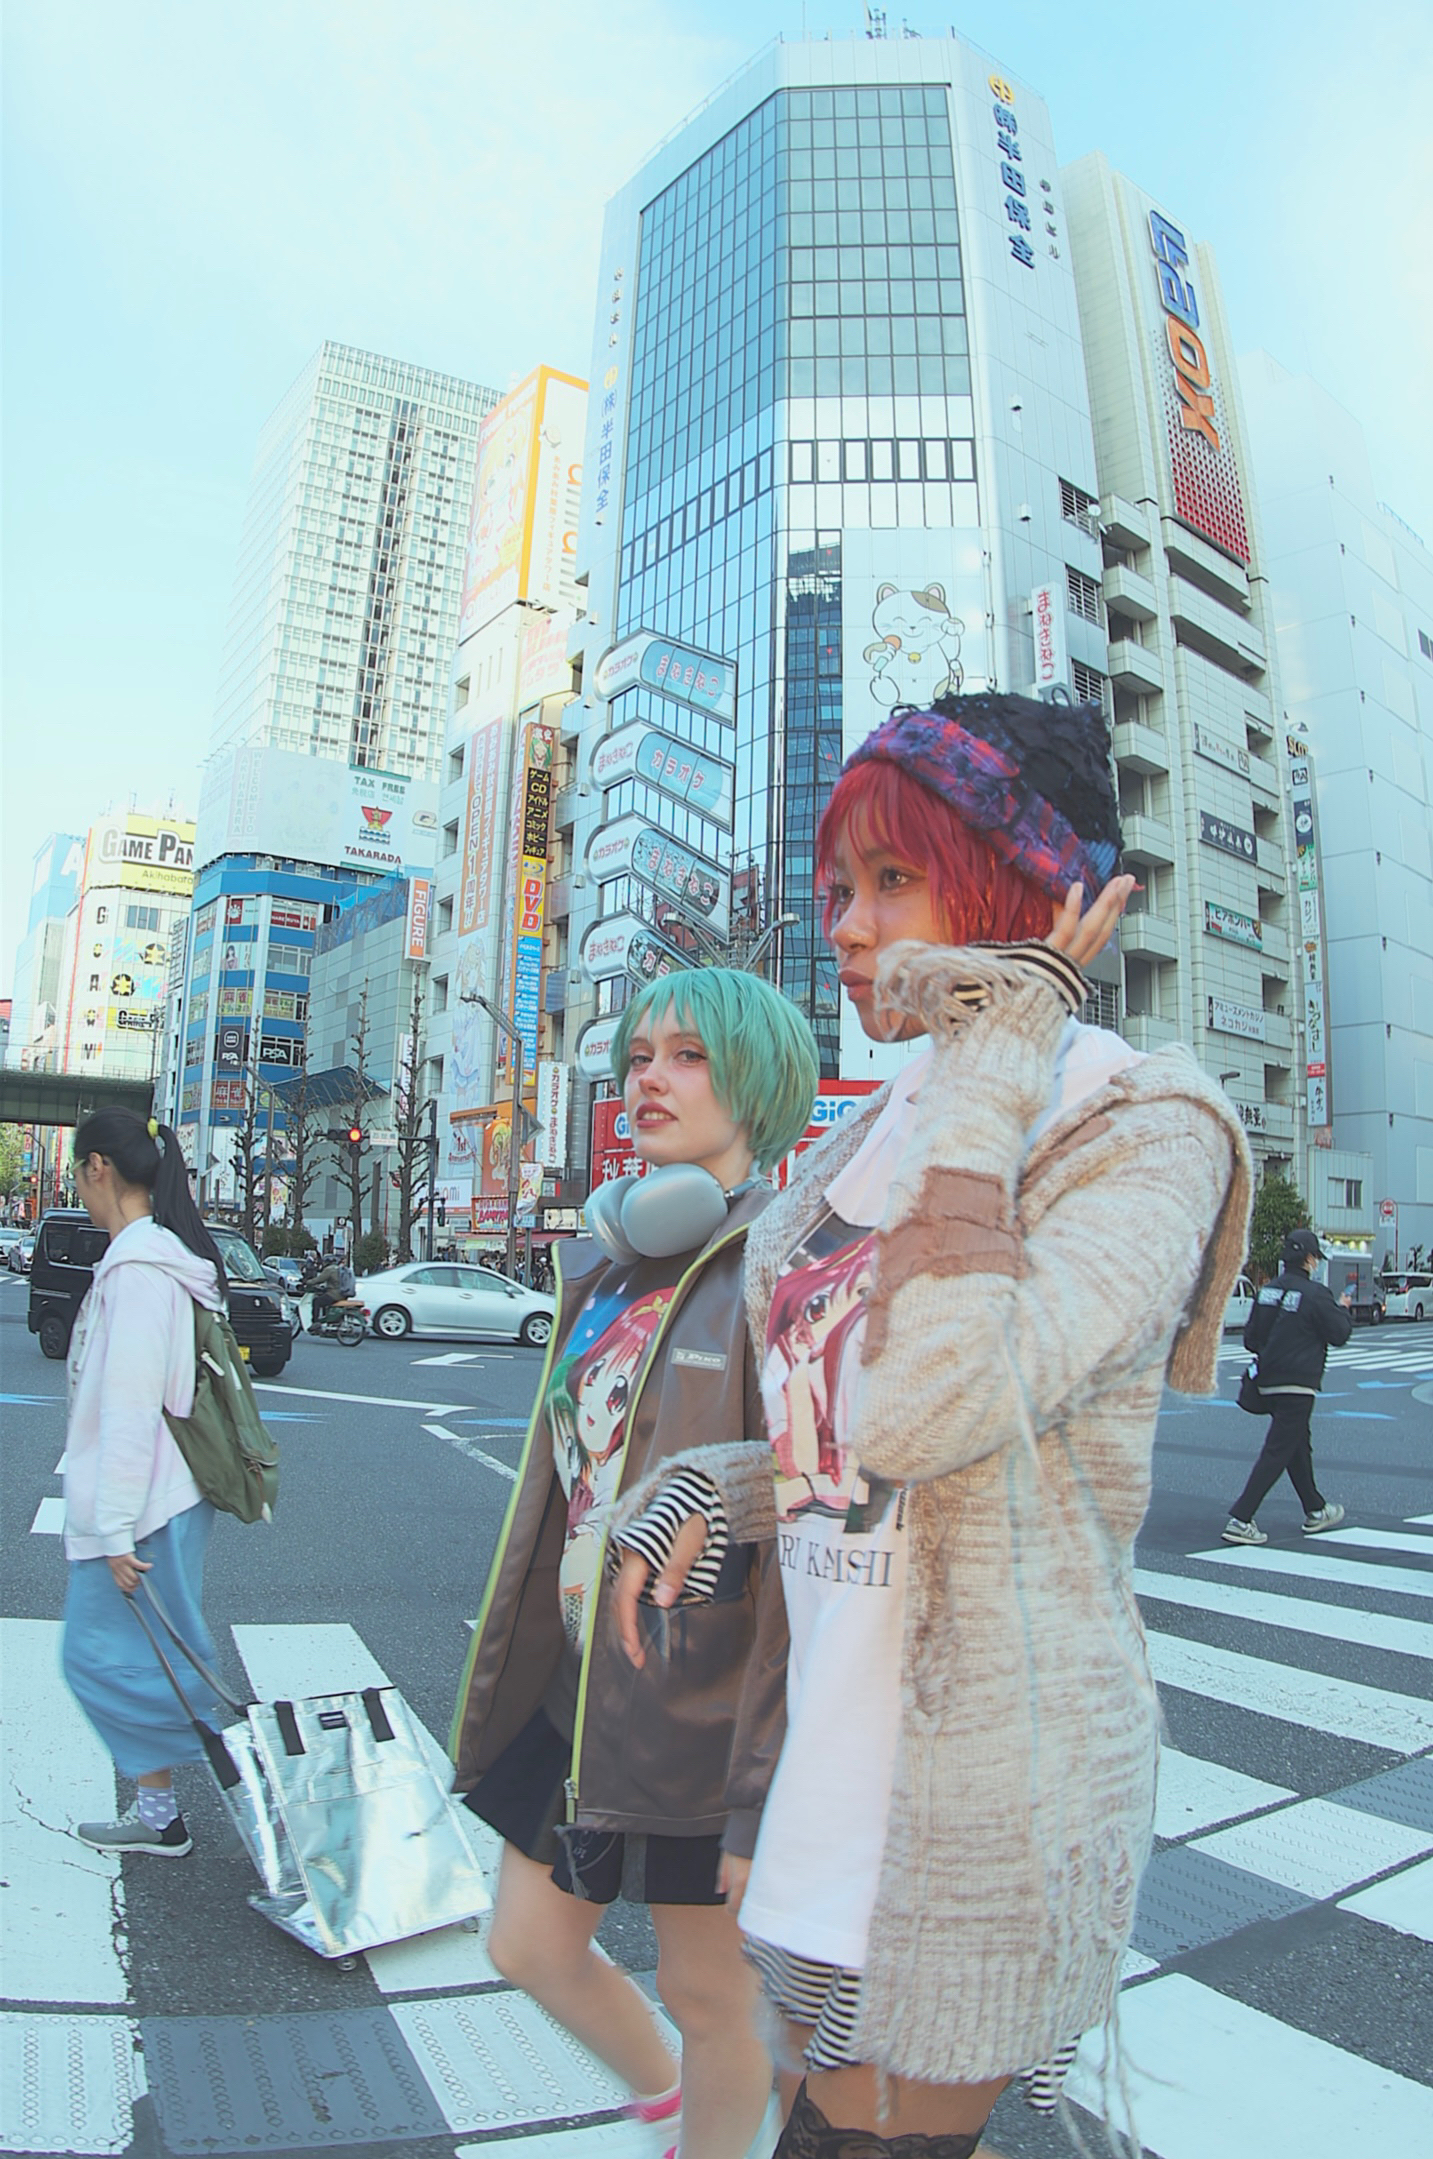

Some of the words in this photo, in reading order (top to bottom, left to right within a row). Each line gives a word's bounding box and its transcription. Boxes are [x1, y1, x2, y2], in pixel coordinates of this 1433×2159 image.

[1037, 591, 1055, 681] まねきねこ
[655, 654, 720, 697] まねきねこ
[530, 769, 550, 782] ゲーム
[597, 741, 634, 775] まねきねこ
[650, 749, 705, 790] カラオケ
[354, 775, 376, 788] TAX
[382, 781, 406, 795] FREE
[530, 781, 548, 794] CD
[469, 796, 481, 851] OPEN
[526, 806, 549, 819] アニメ
[102, 827, 154, 863] GAME
[344, 845, 402, 865] TAKARADA
[596, 837, 625, 858] カラオケ
[647, 846, 714, 906] まねきねこ
[411, 889, 427, 947] FIGURE
[522, 878, 543, 931] DVD
[588, 936, 626, 962] まねきねこ
[263, 1048, 288, 1060] PSA
[551, 1073, 560, 1108] カラオケ
[548, 1116, 559, 1164] まねきねこ
